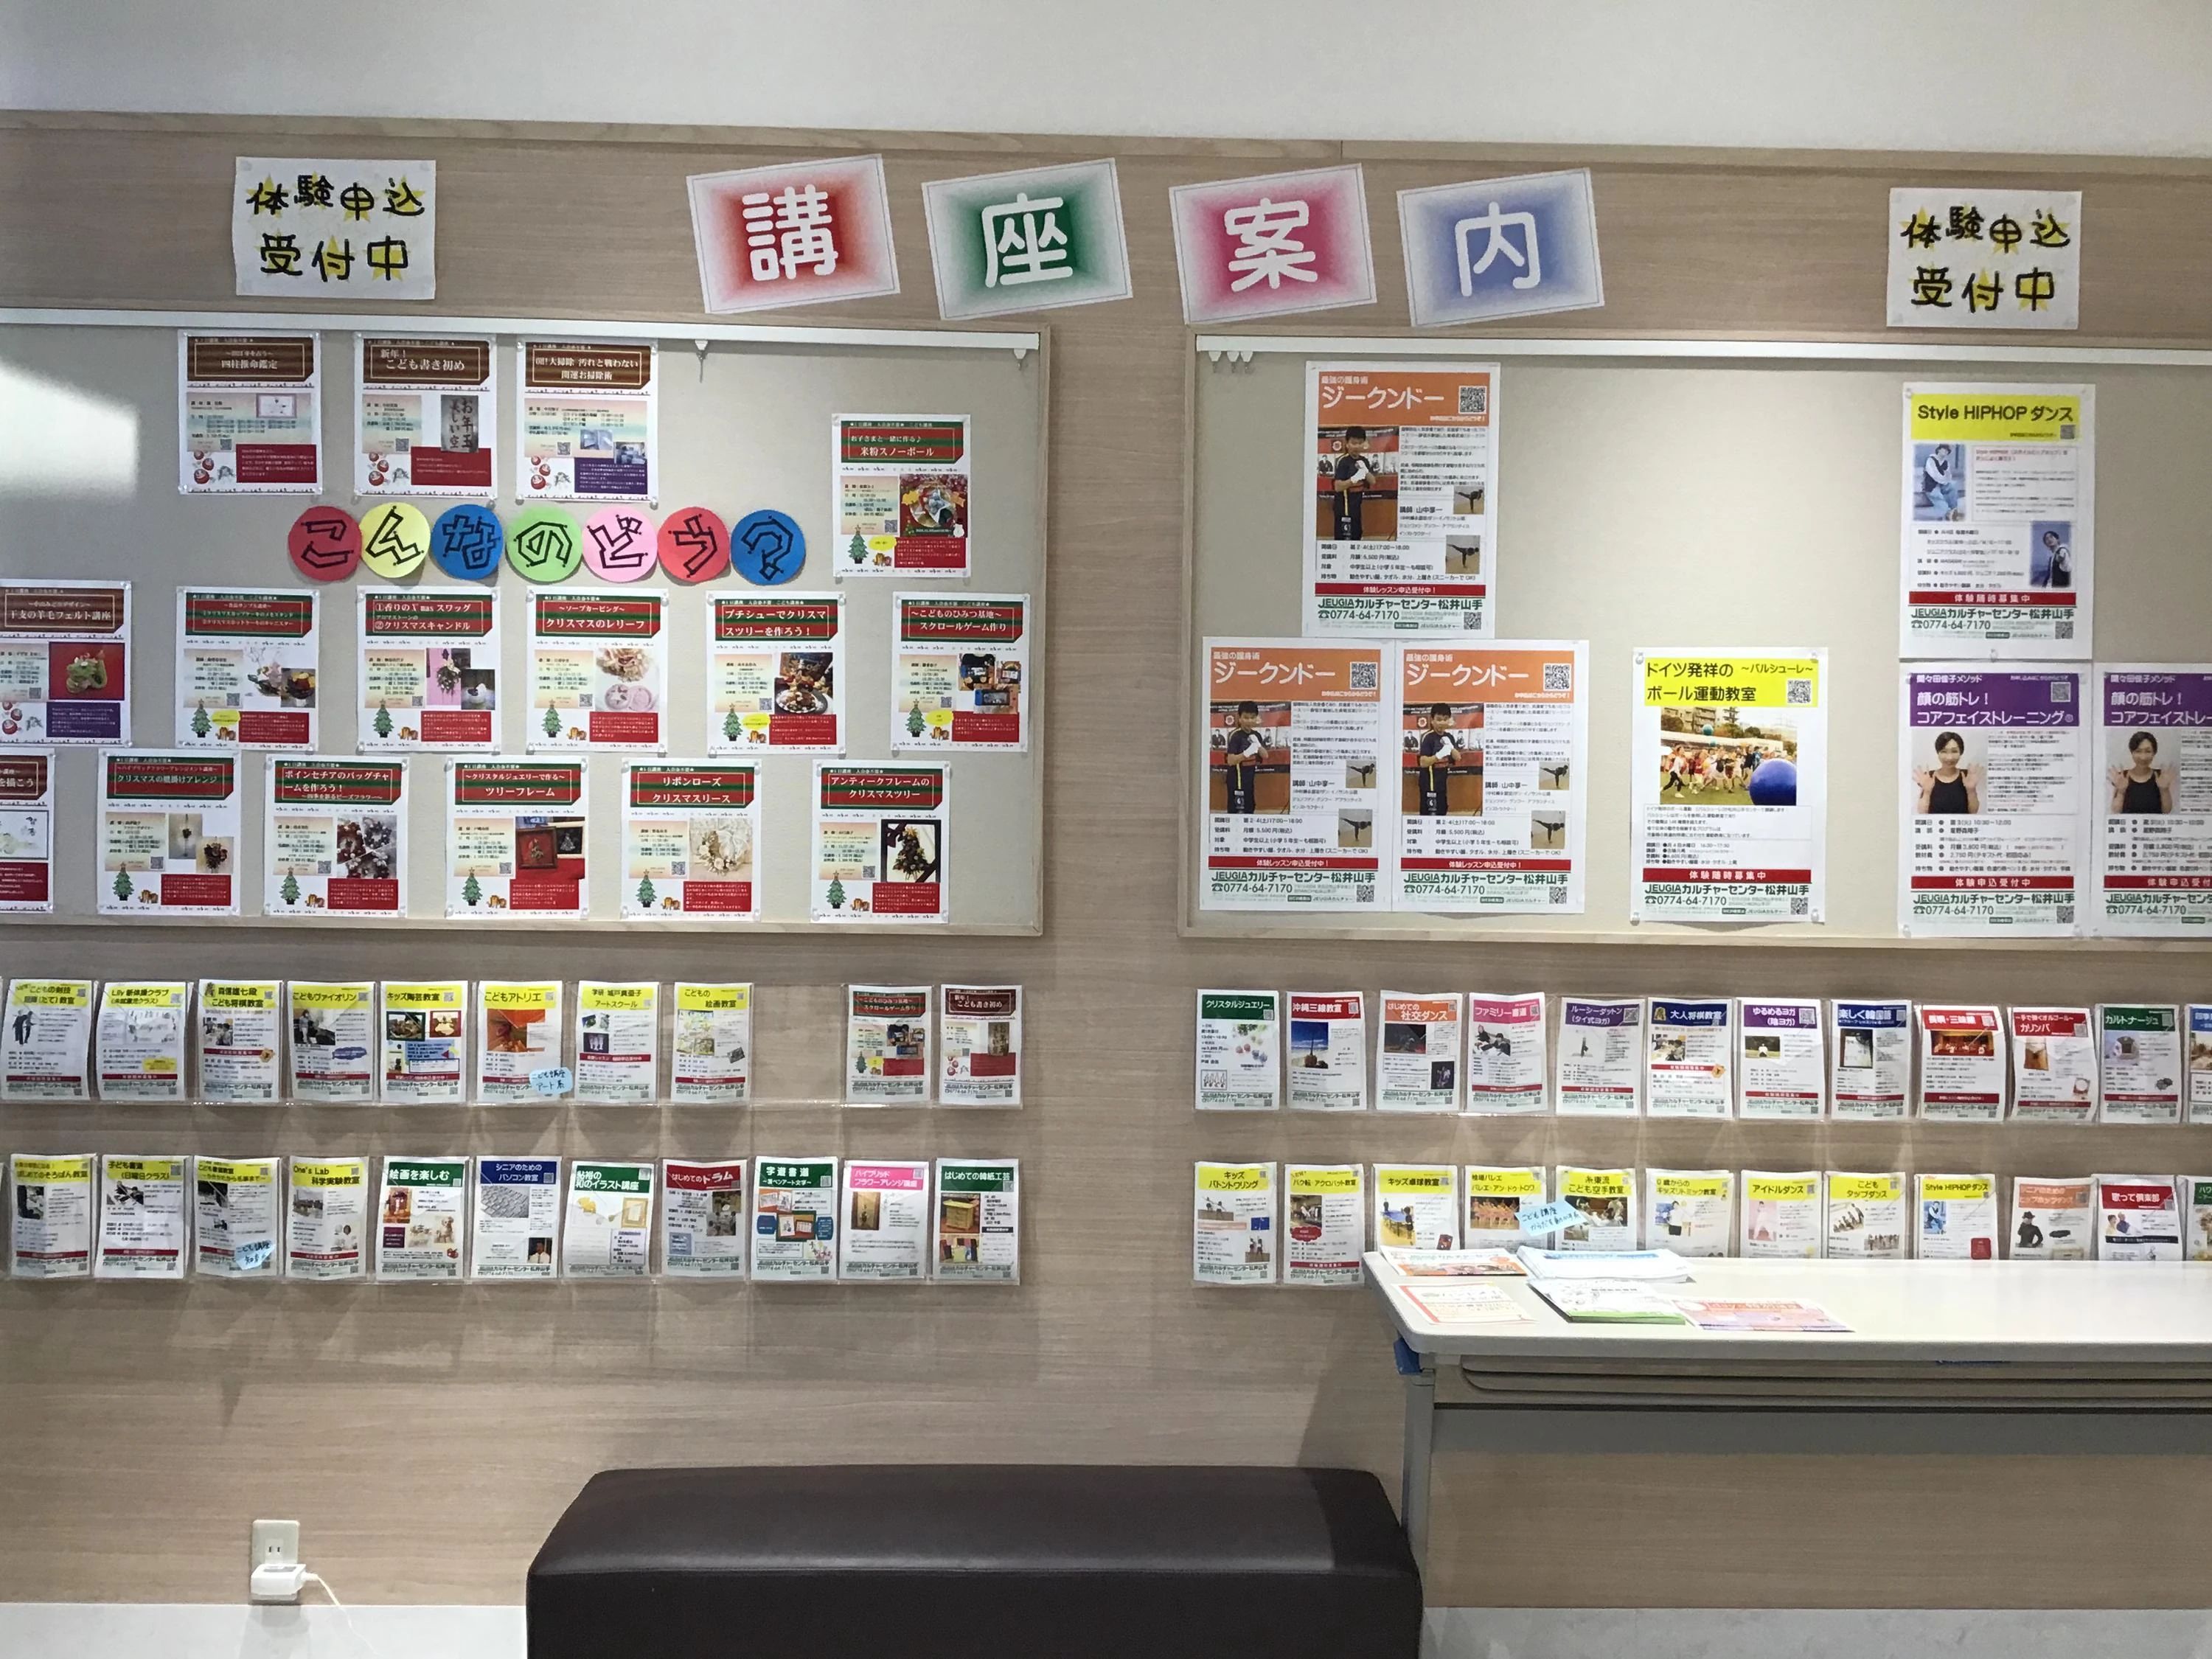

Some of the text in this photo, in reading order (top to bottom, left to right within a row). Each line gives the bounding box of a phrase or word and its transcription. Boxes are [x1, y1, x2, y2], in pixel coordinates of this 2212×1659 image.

[246, 175, 425, 221] 体験申込
[1900, 206, 2070, 254] 体験申込
[260, 233, 408, 282] 受付中
[1911, 267, 2054, 313] 受付中
[386, 360, 465, 370] こども書き初め
[1322, 386, 1444, 410] ジークンドー
[1918, 405, 2073, 422] Style HIPHOP ダンス
[860, 448, 933, 456] 米粉スノーボール
[725, 610, 826, 619] プチシューでクリスマ
[1330, 611, 1399, 620] 0774-64-7170
[546, 619, 644, 629] クリスマスのレリーフ
[920, 622, 1006, 632] スクロールゲーム作り
[1923, 620, 1991, 630] 0774-64-7170
[726, 627, 810, 636] スツリーを作ろう！
[1214, 662, 1335, 684] ジークンドー
[1407, 664, 1528, 687] ジークンドー
[1647, 663, 1733, 678] ドイツ発祥の
[1647, 686, 1756, 701] ボール運動教室
[1917, 692, 1989, 706] 顔の筋トレ！
[2111, 692, 2182, 706] 顔の筋トレ！
[831, 777, 930, 786] アンティークフレームの
[486, 787, 554, 796] ツリーフレーム
[849, 790, 920, 799] クリスマスツリー
[653, 794, 731, 803] クリスマスリース
[1224, 883, 1292, 893] 0774-64-7170
[1416, 885, 1485, 894] 0774-64-7170
[1657, 897, 1727, 905] 0774-64-7170
[1926, 905, 1994, 915] 0774-64-7170
[2118, 905, 2186, 914] 0774-64-7170
[293, 992, 356, 1001] こどもヴァイオリン
[484, 992, 541, 1002] こどもアトリエ
[595, 1000, 637, 1008] アートスクール
[705, 1000, 737, 1008] 絵画教室
[1206, 1001, 1270, 1009] クリスタルジュエリー
[1401, 1010, 1447, 1020] 社交ダンス
[1475, 1007, 1527, 1018] ファミリー書道
[1571, 1006, 1622, 1015] ルーシーダットン
[1670, 1010, 1722, 1020] 大人将棋教室
[2105, 1015, 2159, 1025] カルトナージュ
[2020, 1023, 2051, 1032] カリンバ
[495, 1164, 542, 1172] シニアのための
[389, 1169, 450, 1180] 絵画を楽しむ
[672, 1172, 733, 1184] はじめてのドラム
[1585, 1175, 1610, 1184] 糸東流
[575, 1180, 639, 1191] 和のイラスト講座
[1209, 1180, 1259, 1189] バトントワリング
[1388, 1178, 1439, 1186] キッズ卓球教室
[1569, 1185, 1624, 1194] こども空手教室
[1753, 1184, 1804, 1194] アイドルダンス
[1846, 1190, 1887, 1198] タップダンス
